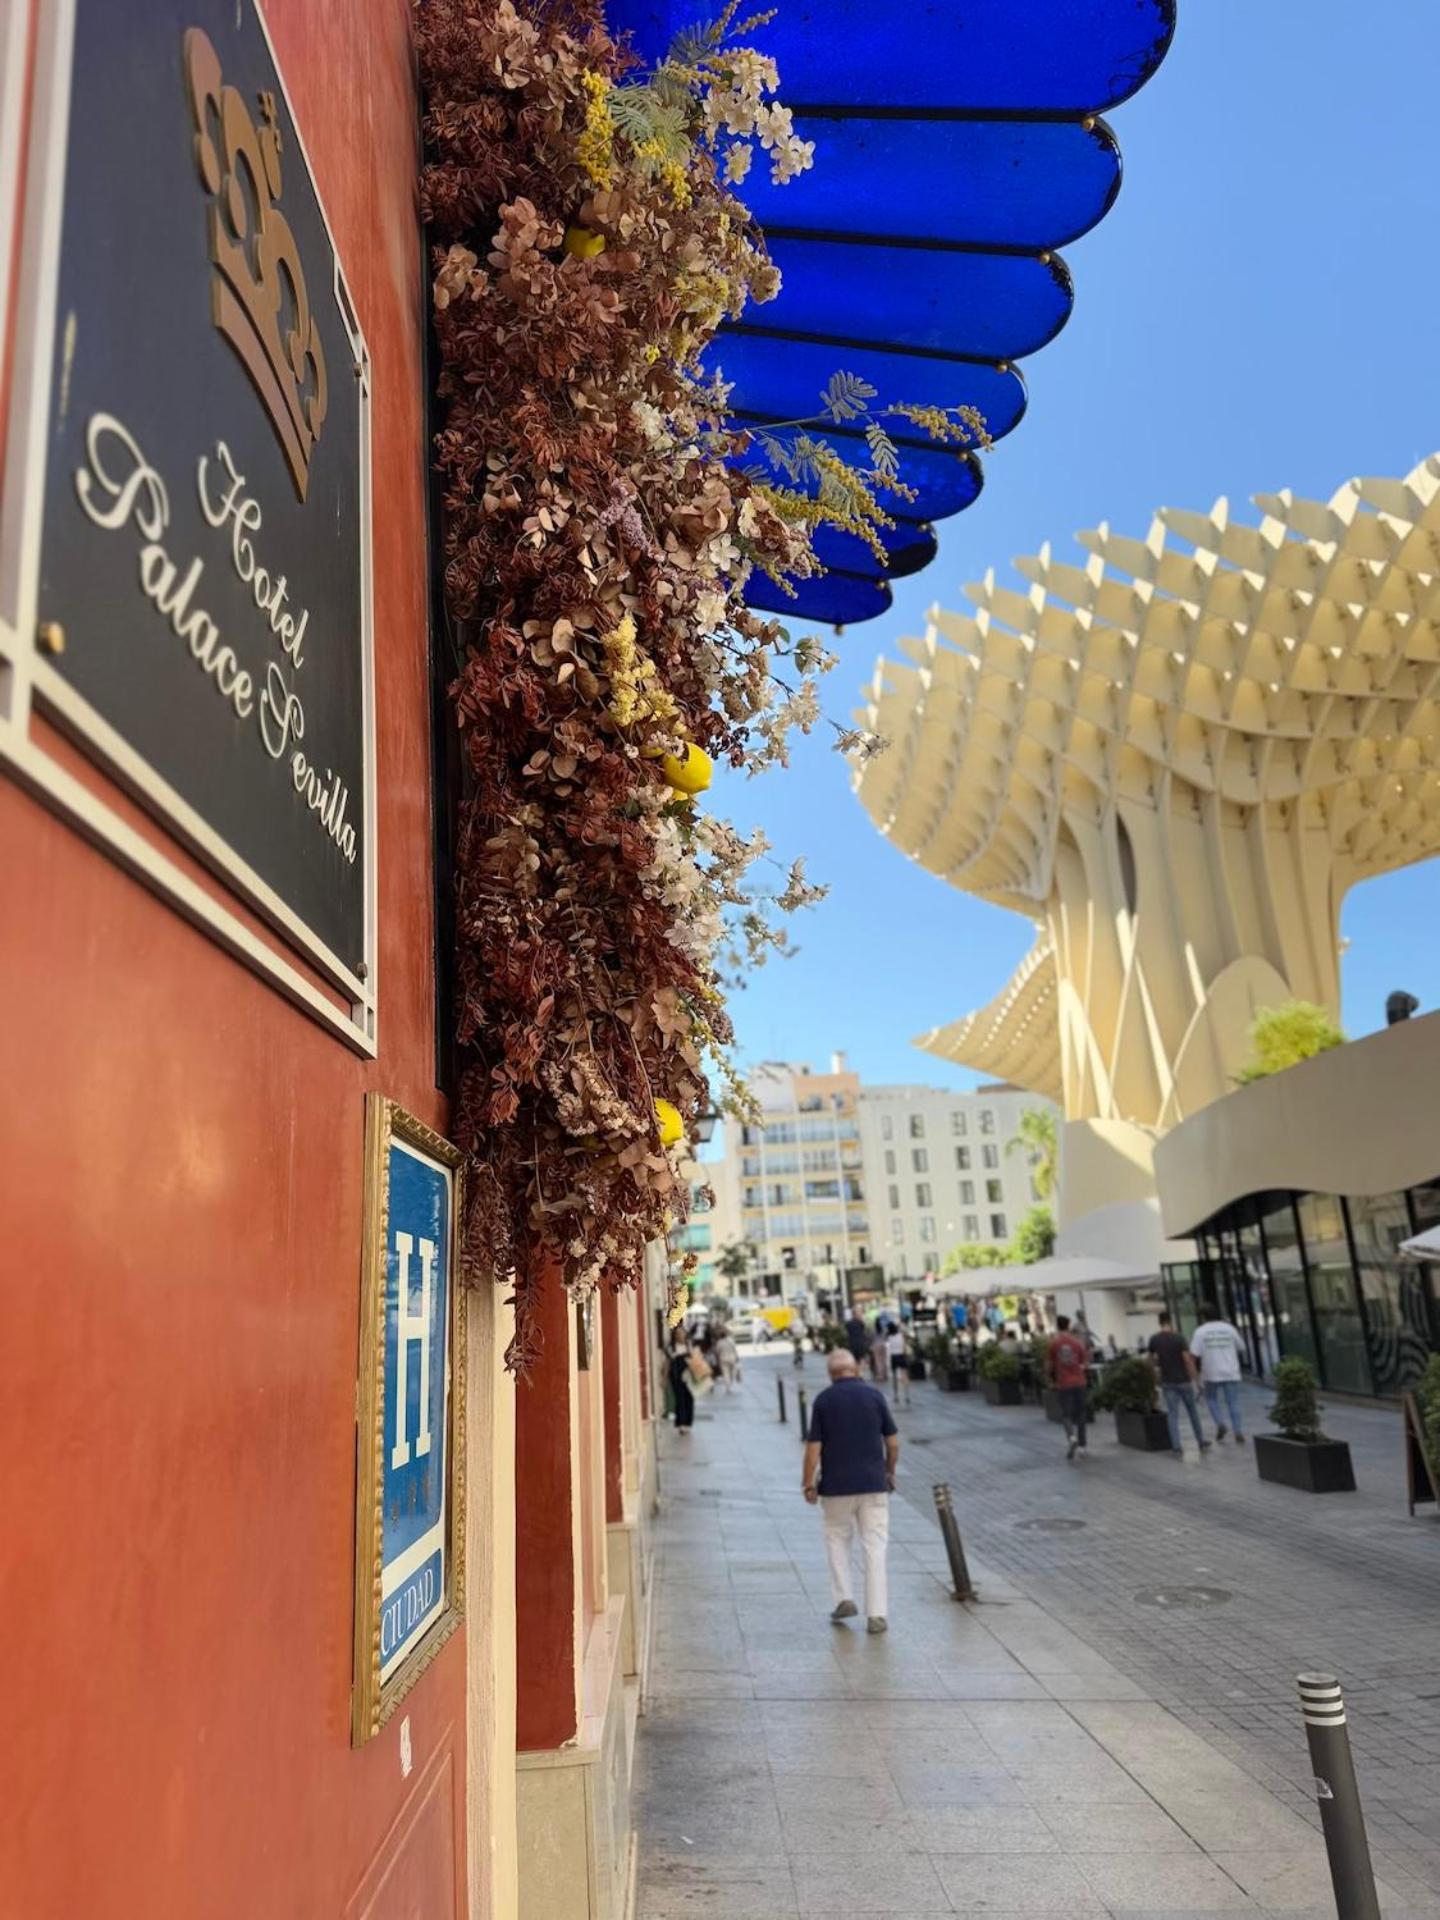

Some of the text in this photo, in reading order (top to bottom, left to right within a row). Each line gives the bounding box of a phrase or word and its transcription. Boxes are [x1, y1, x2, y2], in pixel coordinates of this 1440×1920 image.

[77, 412, 357, 864] Palace Sevilla
[199, 441, 309, 668] Hotel
[392, 1231, 434, 1470] H
[381, 1568, 433, 1656] CIUDAD
